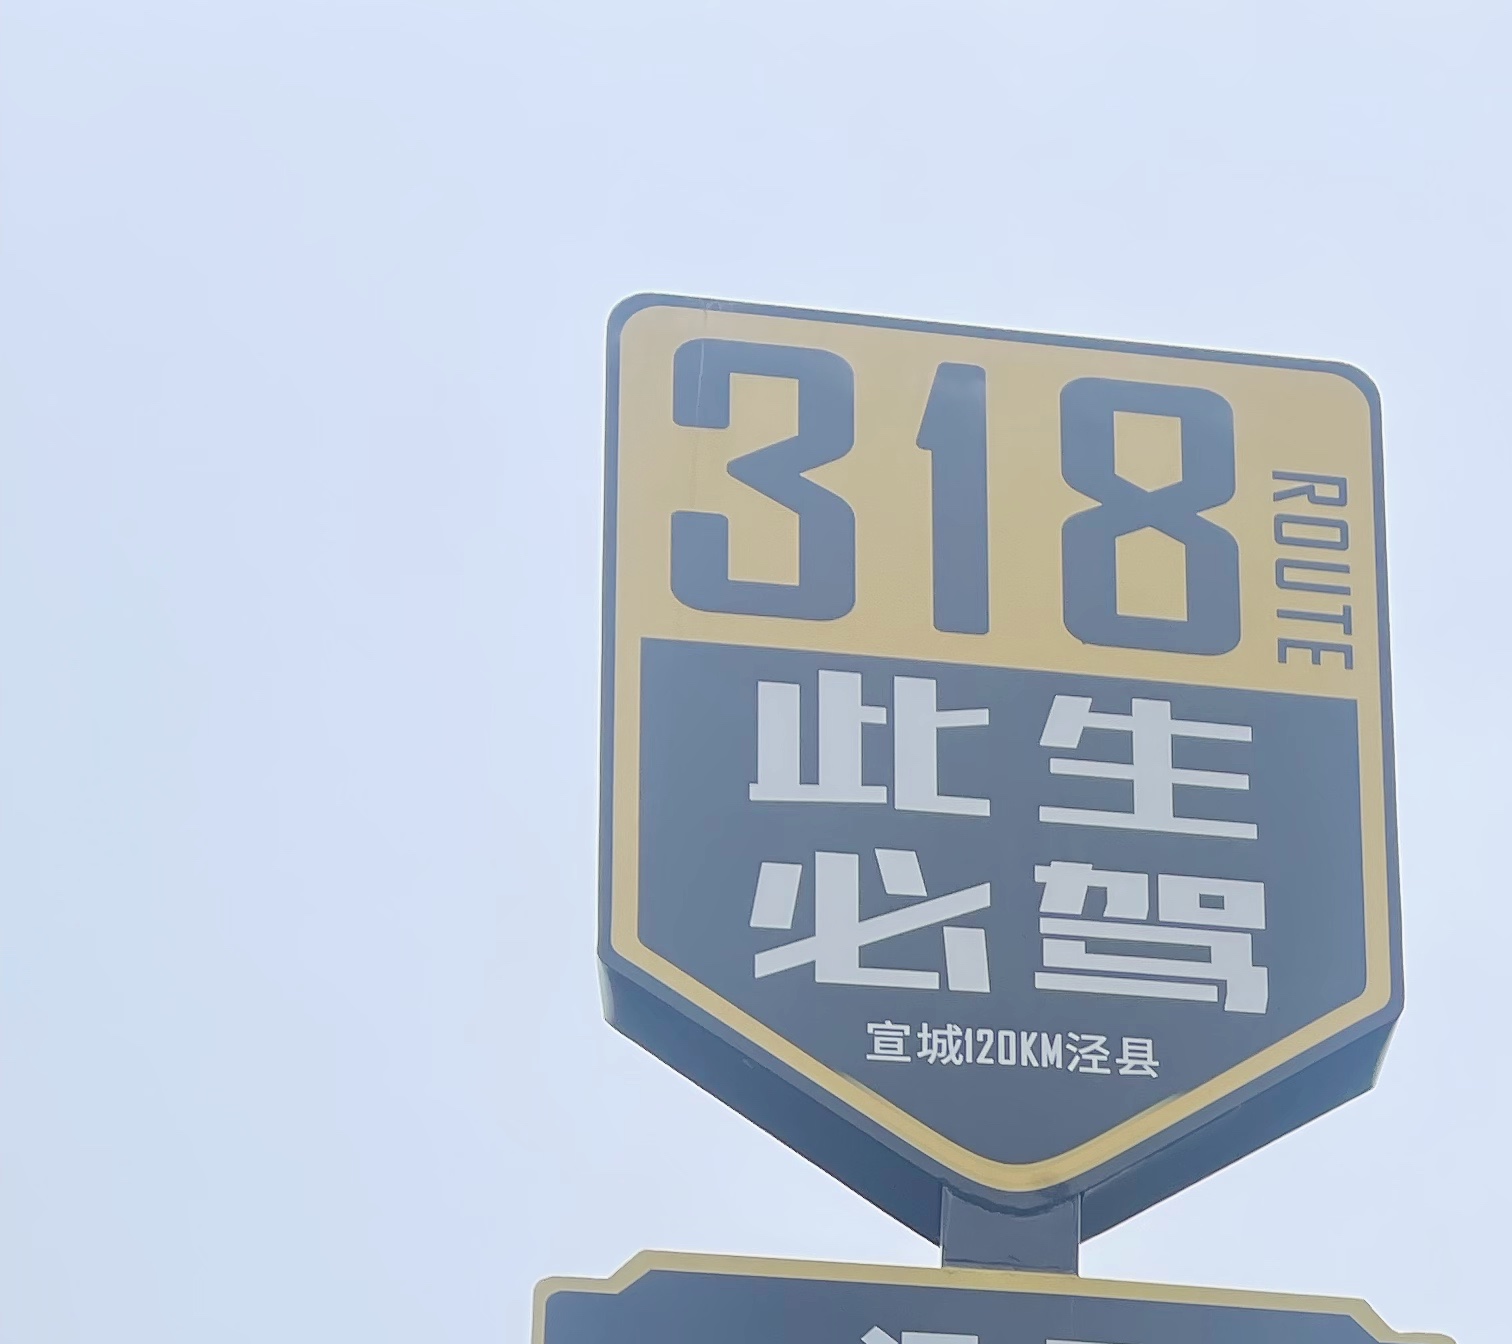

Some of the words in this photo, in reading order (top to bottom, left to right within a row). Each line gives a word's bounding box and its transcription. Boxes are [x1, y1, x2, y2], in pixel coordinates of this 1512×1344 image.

[670, 338, 1241, 656] 318
[1271, 470, 1354, 671] ROUTE
[749, 669, 1258, 840] 此生
[749, 847, 1268, 1014] 必驾
[866, 1020, 1160, 1078] 宣城120KM泾县
